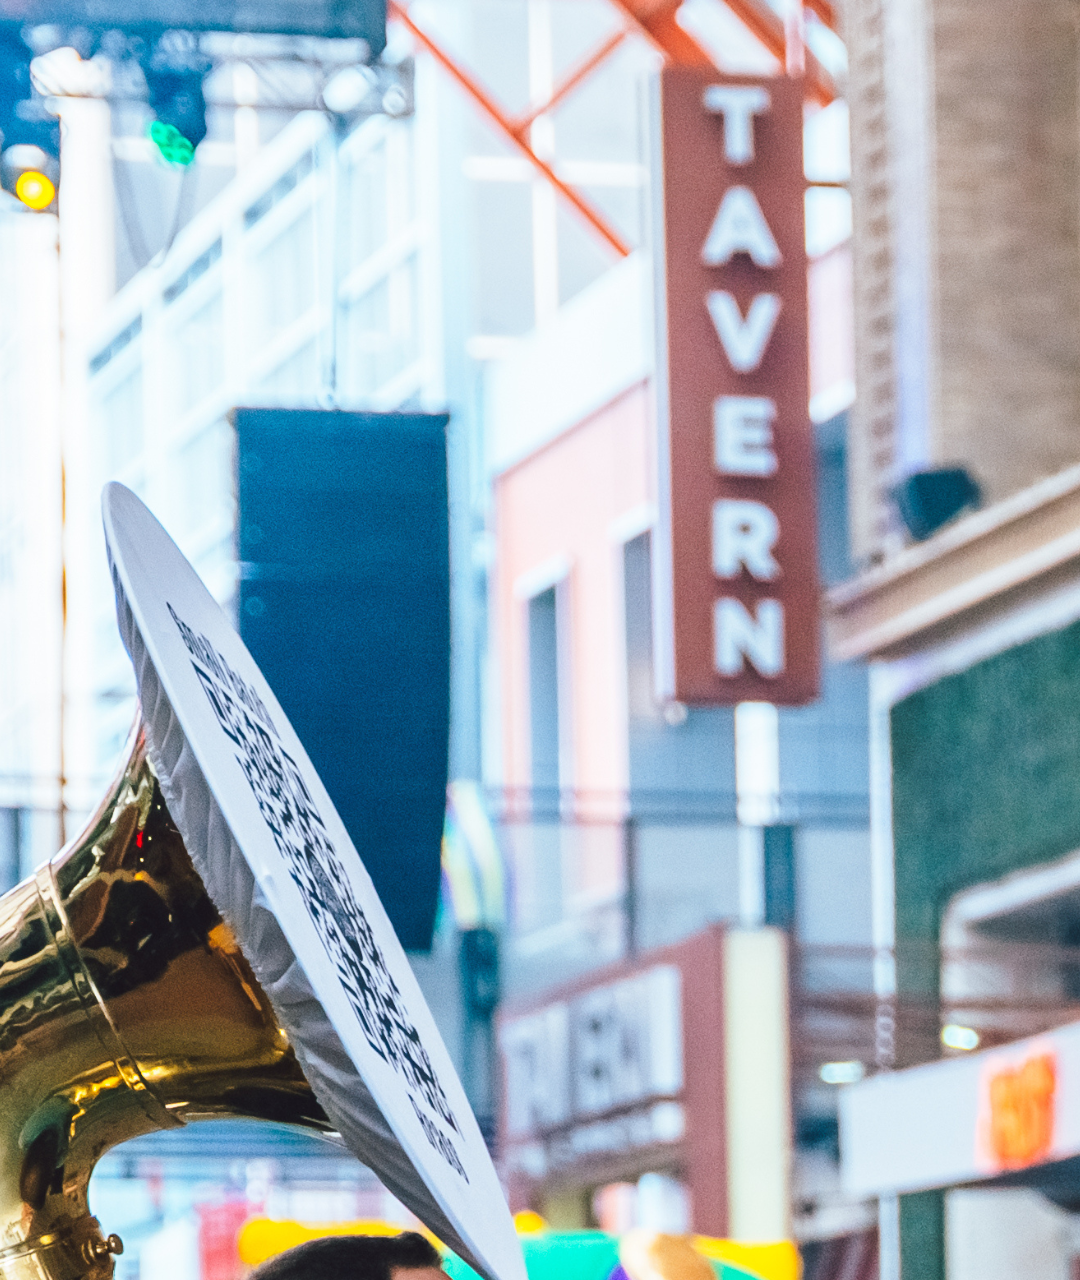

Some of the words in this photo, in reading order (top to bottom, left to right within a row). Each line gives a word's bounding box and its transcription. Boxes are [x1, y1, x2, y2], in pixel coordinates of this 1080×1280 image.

[701, 85, 785, 679] TAVERN
[166, 601, 232, 691] Small
[218, 651, 282, 741] Batch
[406, 1091, 470, 1186] Brass
